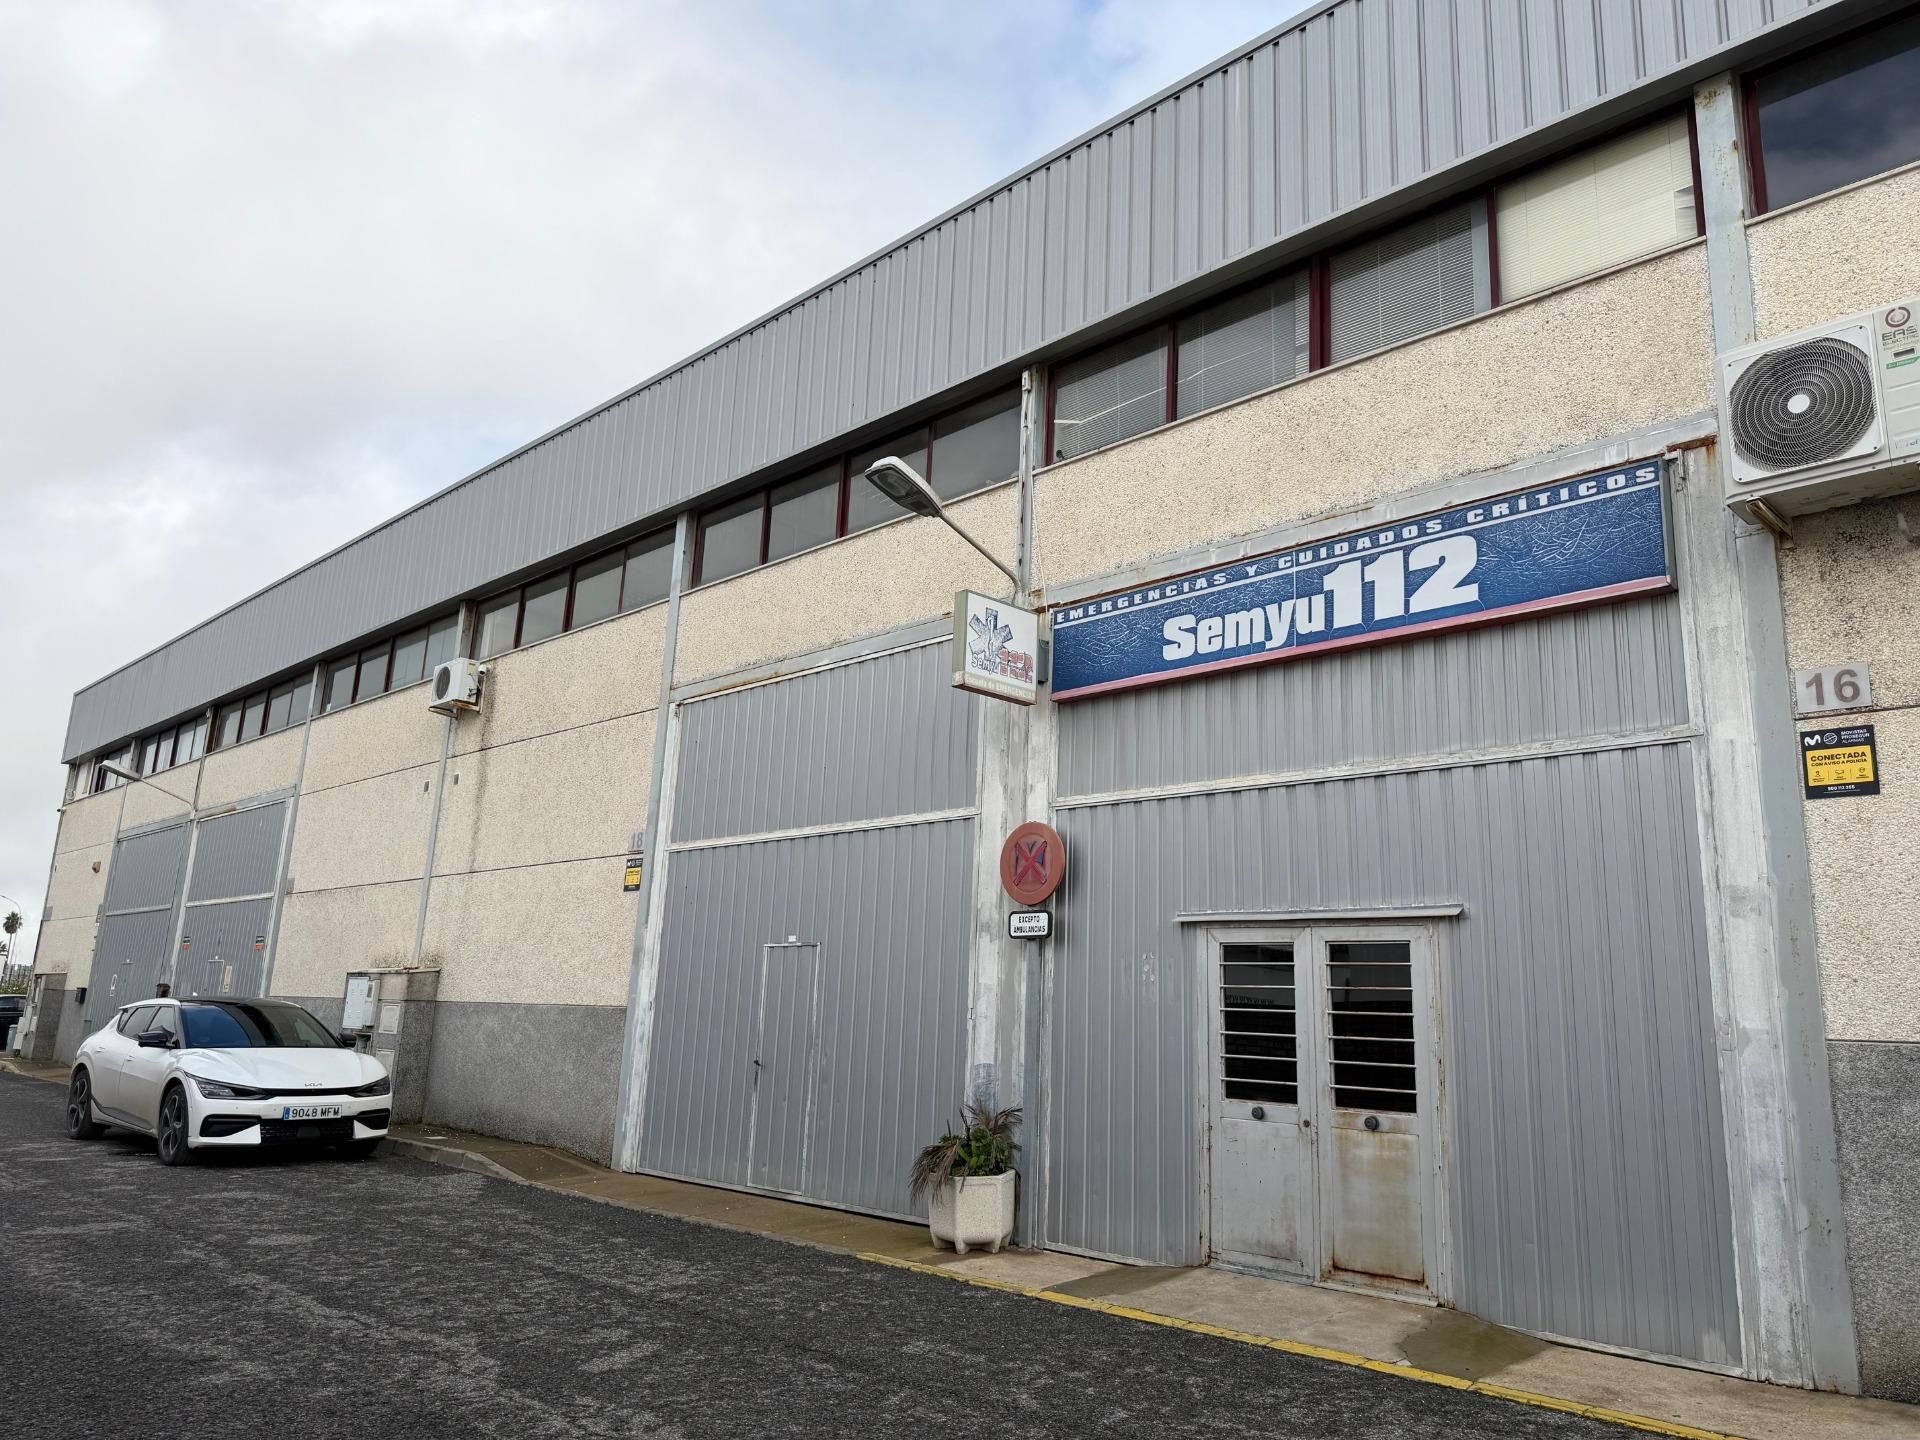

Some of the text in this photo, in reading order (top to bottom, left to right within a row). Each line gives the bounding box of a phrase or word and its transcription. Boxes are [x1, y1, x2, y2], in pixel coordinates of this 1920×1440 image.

[1881, 325, 1918, 341] EAS
[1056, 466, 1656, 623] EMERGENCIAS Y CUIDADOS CRÍTICOS
[1805, 669, 1861, 706] 16
[1810, 751, 1867, 762] CONECTADA
[631, 832, 643, 849] 18
[1018, 915, 1040, 924] EXCEPTO
[1013, 925, 1046, 934] AMBULANCIAS
[291, 1108, 318, 1118] 9048
